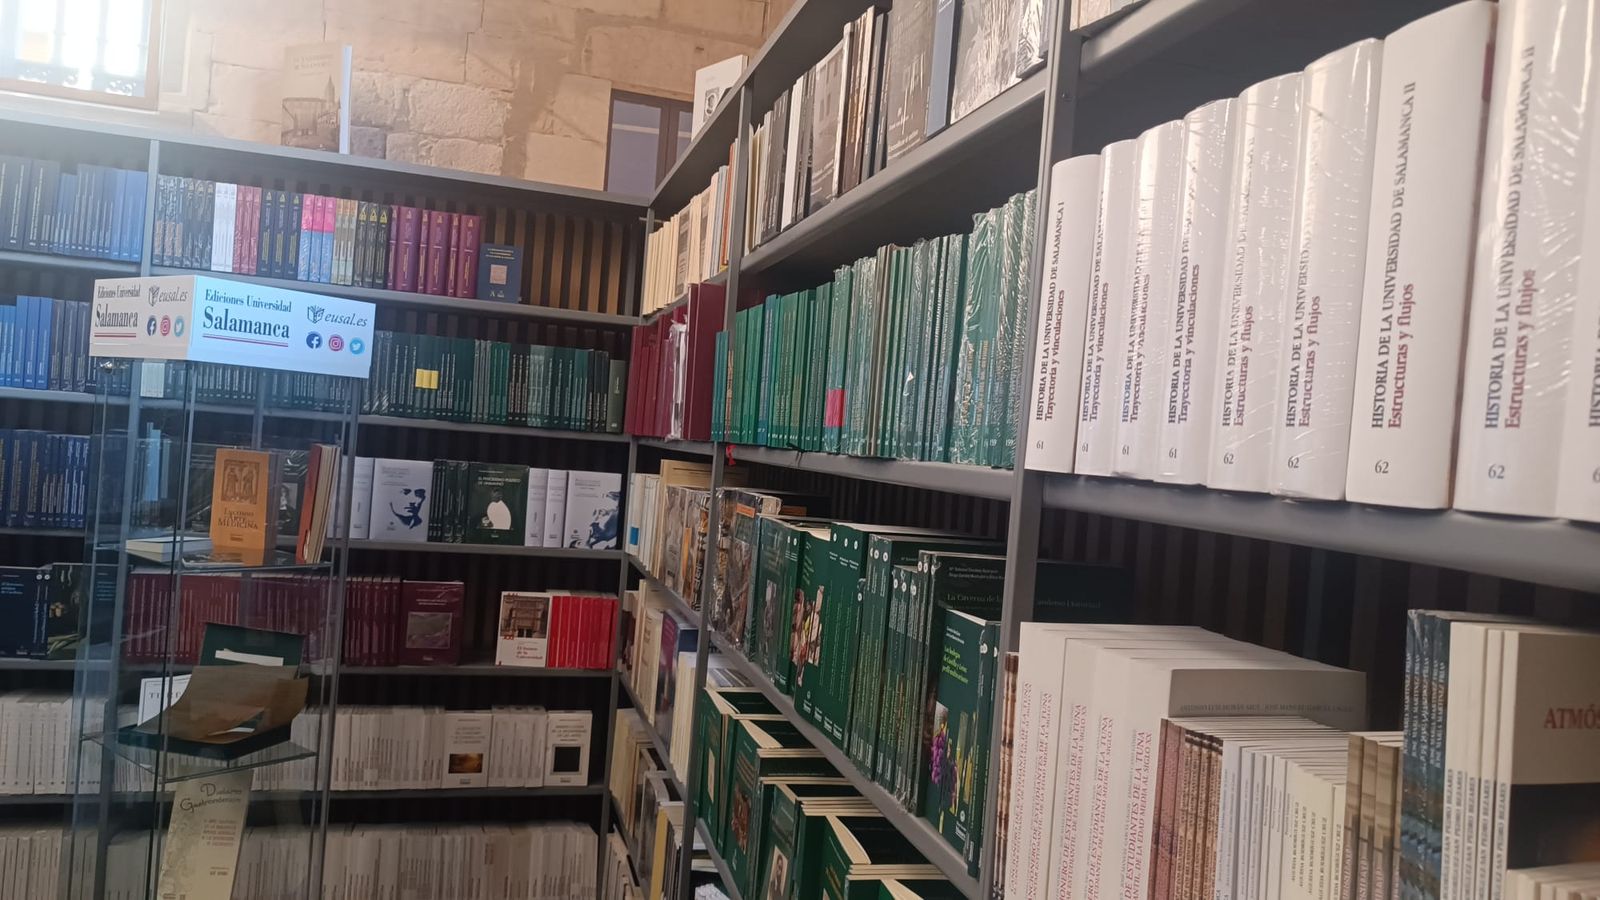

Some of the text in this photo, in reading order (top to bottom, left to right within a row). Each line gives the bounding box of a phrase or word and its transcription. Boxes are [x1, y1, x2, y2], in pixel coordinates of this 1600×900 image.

[1052, 207, 1064, 265] SALAMANCA
[1485, 46, 1535, 429] HISTORIA DE LA UNIVERSIDAD DE SALAMANCA II
[1371, 81, 1416, 428] HISTORIA DE LA UNIVERSIDAD DE SALAMANCA II
[1050, 266, 1058, 280] DE
[97, 283, 141, 298] Ediciones Universidad
[159, 286, 188, 302] eusal.es
[1176, 256, 1189, 333] UNIVERSIDAD
[205, 289, 292, 313] Ediciones Universidad
[94, 303, 139, 328] Salamanca
[202, 306, 290, 339] Salamanca
[324, 312, 368, 328] eusal.es
[1044, 282, 1056, 345] UNIVERSIDAD
[1082, 258, 1101, 421] HISTORIA DE LA UNIVERSIDAD DE
[1229, 330, 1238, 346] LA
[1293, 323, 1304, 340] LA
[1089, 365, 1101, 422] Trayectoria
[1096, 282, 1109, 352] vinculaciones
[1128, 340, 1135, 354] LA
[1174, 335, 1183, 350] LA
[1178, 263, 1200, 424] Trayectoria y vinculaciones
[1292, 342, 1302, 361] DE
[1505, 268, 1539, 429] Estructuras y flujos
[1045, 347, 1050, 359] LA
[1045, 290, 1065, 421] Trayectoria y vinculaciones
[1126, 355, 1134, 370] DE
[1173, 351, 1181, 368] DE
[1227, 347, 1237, 366] DE
[1299, 295, 1322, 428] Estructuras y flujos
[1388, 283, 1416, 428] Estructuras y flujos
[1041, 361, 1048, 374] DE
[1233, 305, 1255, 427] Estructuras y flujos
[1036, 376, 1047, 421] HISTORIA
[1122, 372, 1132, 422] HISTORIA
[1130, 361, 1142, 423] Trayectoria
[1168, 370, 1180, 424] HISTORIA
[1222, 370, 1235, 427] HISTORIA
[1286, 364, 1300, 428] HISTORIA
[1036, 441, 1044, 450] 61
[1082, 443, 1089, 452] 61
[1122, 445, 1130, 456] 61
[1168, 447, 1177, 459] 61
[1223, 452, 1234, 464] 62
[1287, 456, 1300, 468] 62
[1374, 460, 1389, 474] 62
[1488, 464, 1505, 479] 62
[1073, 705, 1081, 732] TUNA
[1071, 737, 1078, 750] LA
[1135, 732, 1145, 763] TUNA
[1145, 733, 1152, 745] XX
[1070, 752, 1077, 766] DE
[1134, 768, 1142, 781] LA
[1142, 775, 1149, 786] AL
[1089, 717, 1109, 877] DE ESTUDIANTES DE LA TUNA
[1132, 783, 1140, 800] DE
[1064, 770, 1075, 841] ESTUDIANTES
[1139, 788, 1148, 816] MEDIA
[1137, 818, 1145, 843] EDAD
[1125, 802, 1139, 880] ESTUDIANTES
[1136, 845, 1143, 856] LA
[1063, 845, 1070, 858] DE
[1134, 857, 1142, 870] DE
[1124, 882, 1132, 899] DE
